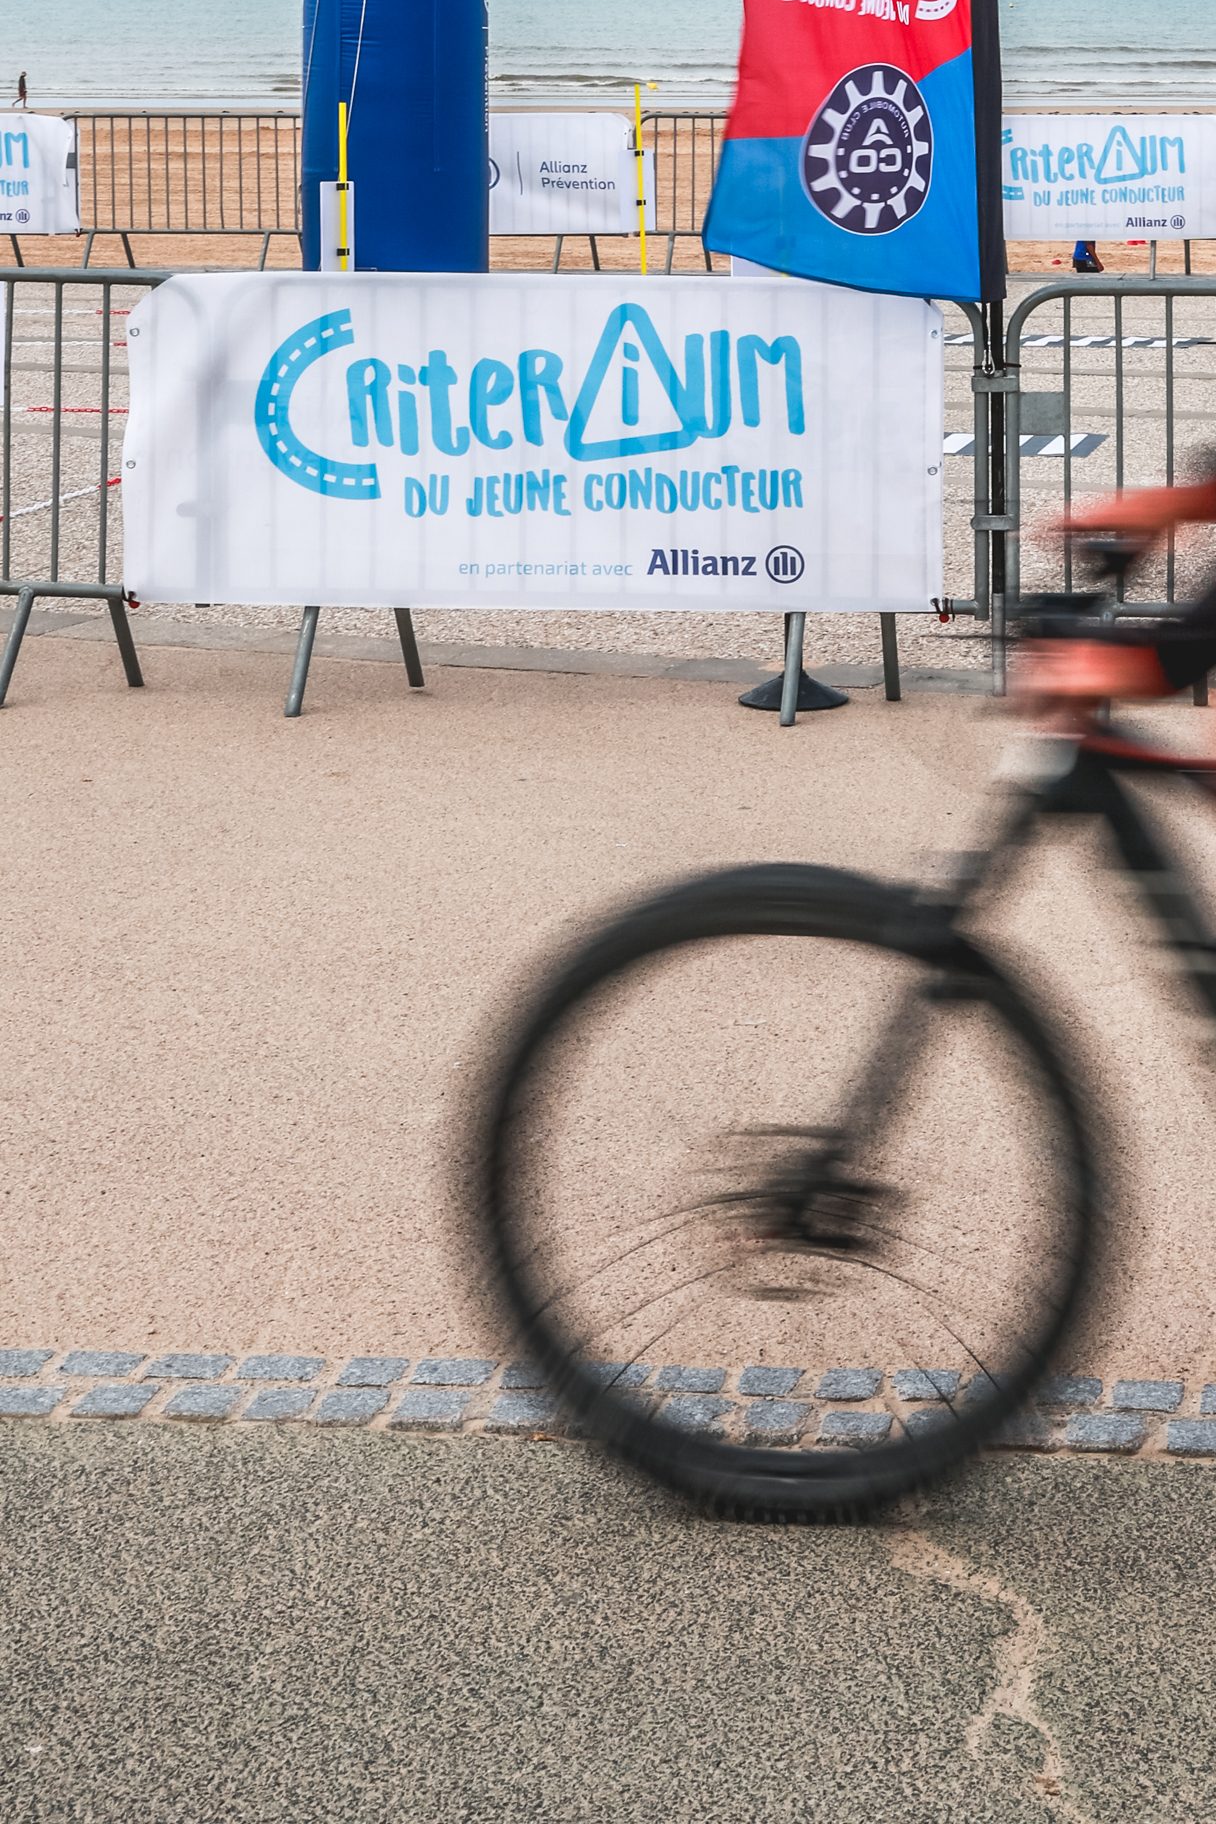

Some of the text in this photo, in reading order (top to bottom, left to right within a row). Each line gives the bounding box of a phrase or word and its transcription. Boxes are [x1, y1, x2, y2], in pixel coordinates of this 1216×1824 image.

[539, 160, 588, 174] Allianz
[541, 176, 616, 190] Prévention
[1033, 185, 1185, 207] DU JEUNE CONDUCTEUR
[1125, 217, 1168, 228] Allianz
[404, 465, 804, 518] DU JEUNE CONDUCTEUR
[458, 548, 758, 578] en partenariat avec Allianz
